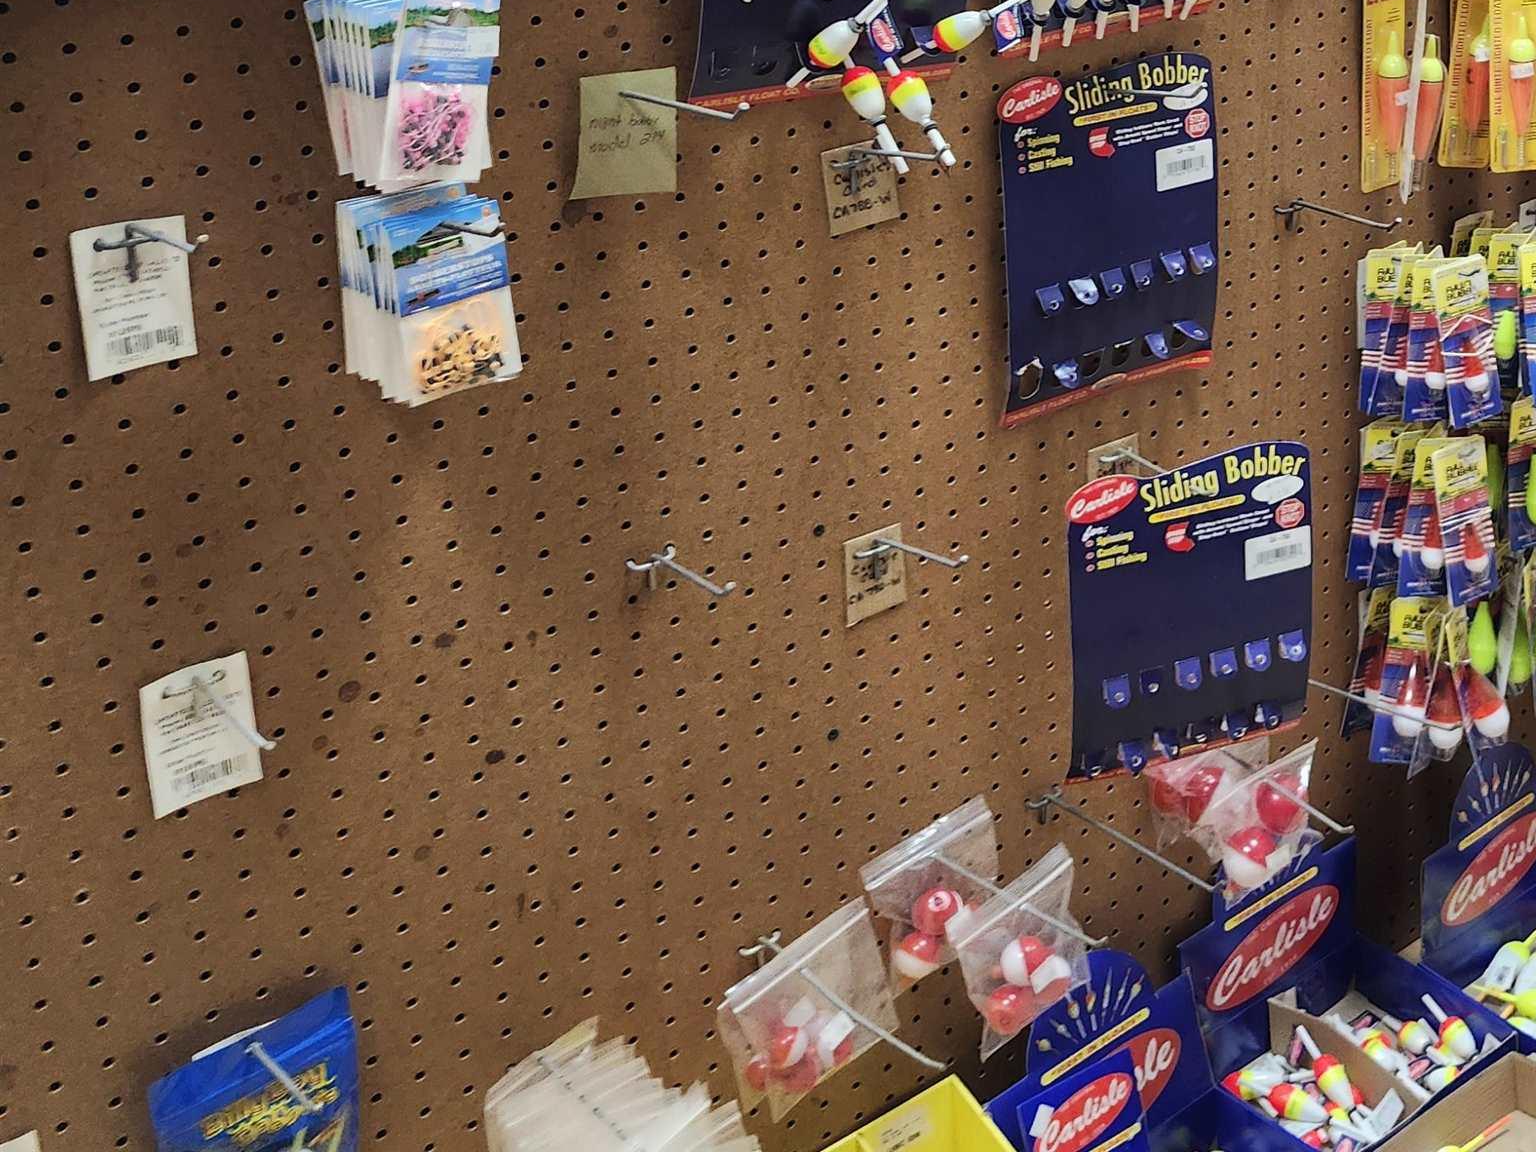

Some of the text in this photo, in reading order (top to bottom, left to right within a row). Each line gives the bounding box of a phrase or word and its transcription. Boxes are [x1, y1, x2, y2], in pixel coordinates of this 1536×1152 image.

[750, 91, 782, 103] FLOAT
[1002, 82, 1060, 118] Carlisle
[1064, 54, 1208, 115] Sliding Bobber
[1070, 481, 1136, 519] Carlisle
[1140, 444, 1307, 513] Sliding Bobber
[1212, 891, 1334, 1005] Carlisle
[1036, 1074, 1131, 1152] Carlisle
